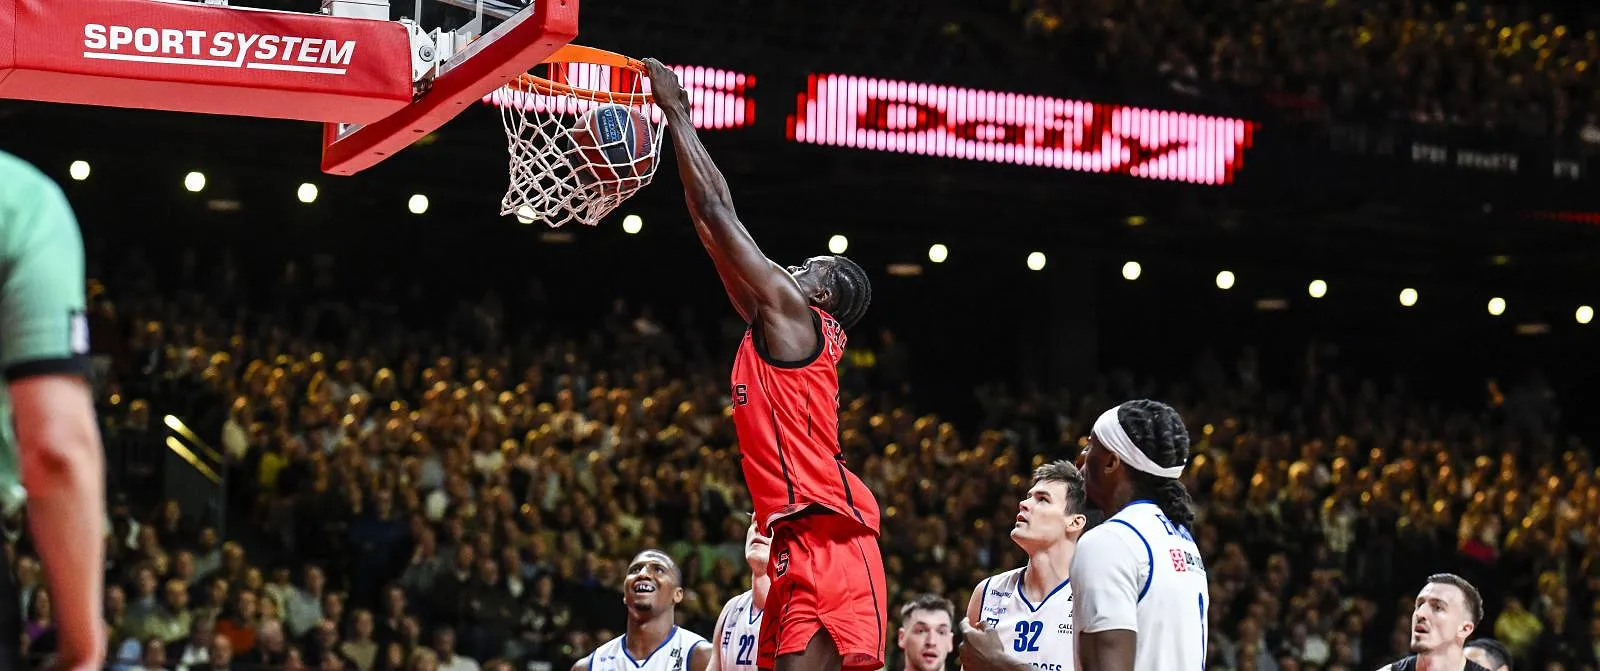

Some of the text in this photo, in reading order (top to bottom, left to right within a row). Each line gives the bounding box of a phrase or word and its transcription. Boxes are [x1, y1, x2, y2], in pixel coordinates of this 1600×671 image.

[83, 23, 357, 67] SPORT SYSTEM
[735, 634, 755, 665] 22
[1013, 620, 1044, 652] 32
